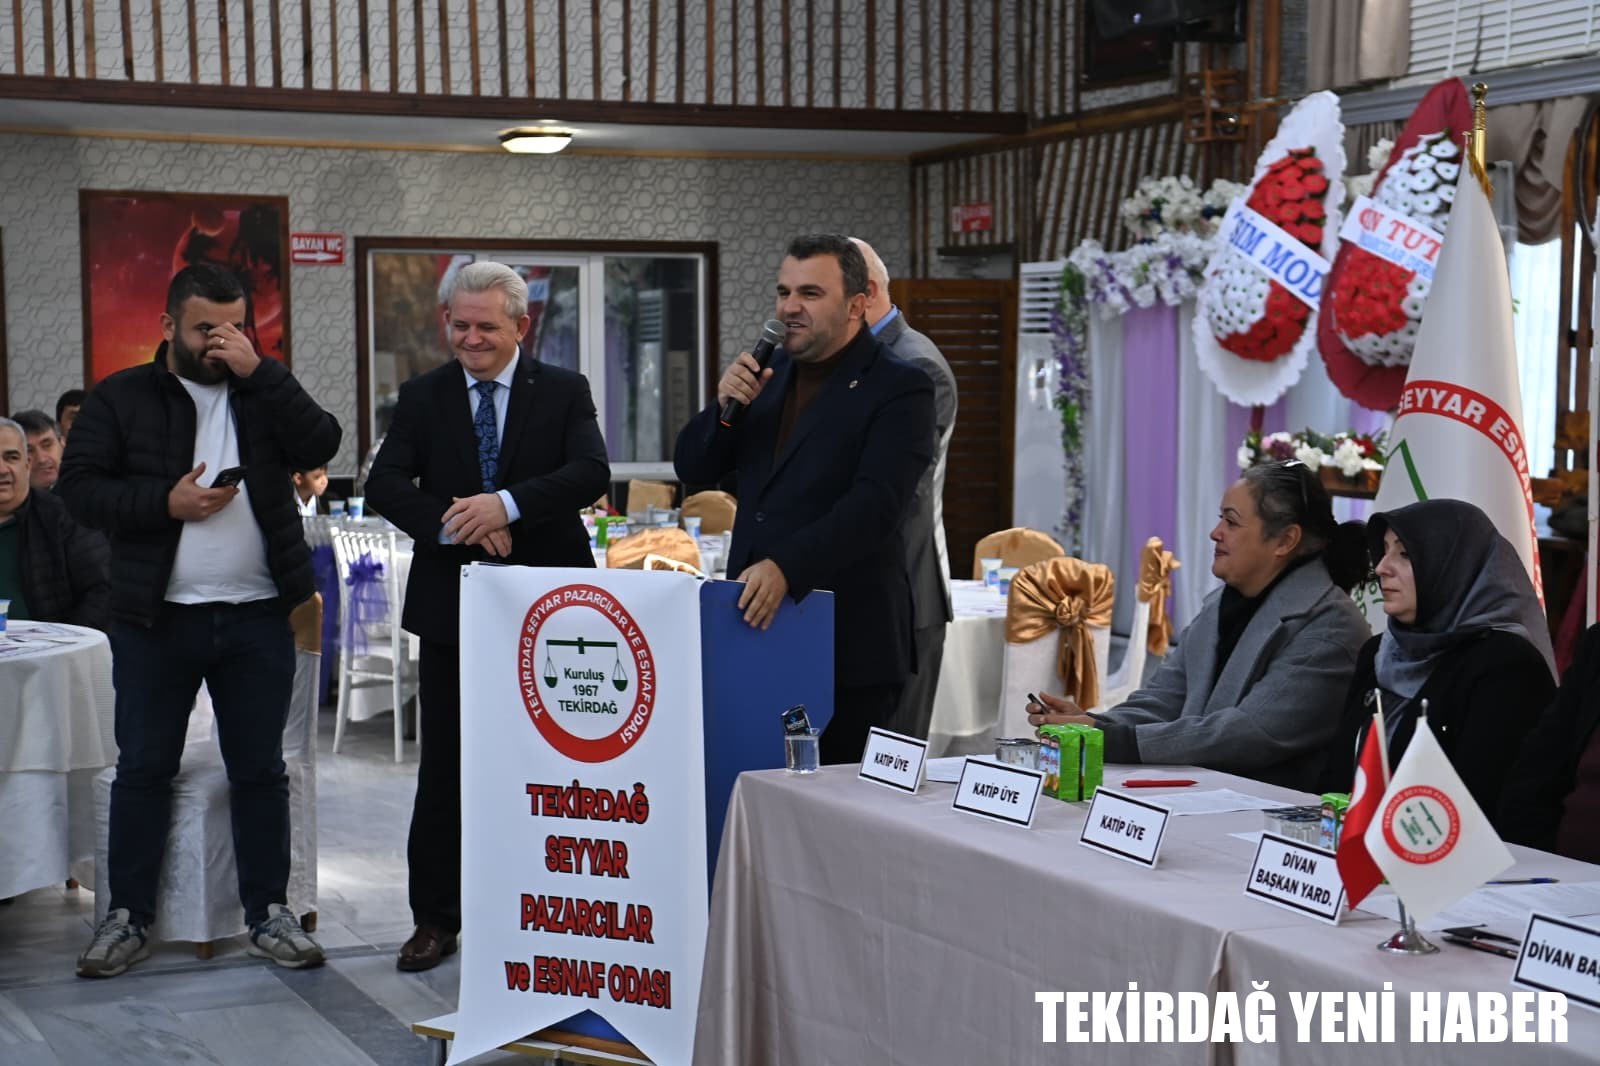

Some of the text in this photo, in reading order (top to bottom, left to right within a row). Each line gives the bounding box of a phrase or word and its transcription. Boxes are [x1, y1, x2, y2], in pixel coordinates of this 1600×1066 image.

[326, 238, 343, 252] WC
[1260, 241, 1322, 299] MOD
[522, 590, 652, 744] TEKİRDAĞ SEYYAR PAZARCILAR VE ESNAF ODASI
[564, 668, 604, 682] Kuruluş
[573, 685, 599, 697] 1967
[558, 698, 618, 714] TEKİRDAĞ
[874, 751, 909, 772] KATİP ÜYE
[526, 779, 649, 824] TEKİRDAĞ
[972, 781, 1020, 804] KATİP ÜYE
[1099, 814, 1146, 841] KATİP ÜYE
[545, 834, 630, 879] SEYYAR
[1282, 850, 1317, 875] DİVAN
[1255, 868, 1332, 906] BAŞKAN YARD.
[520, 893, 654, 944] PAZARCILAR
[1528, 939, 1575, 970] DİVAN
[504, 955, 672, 1010] ve ESNAF ODASI
